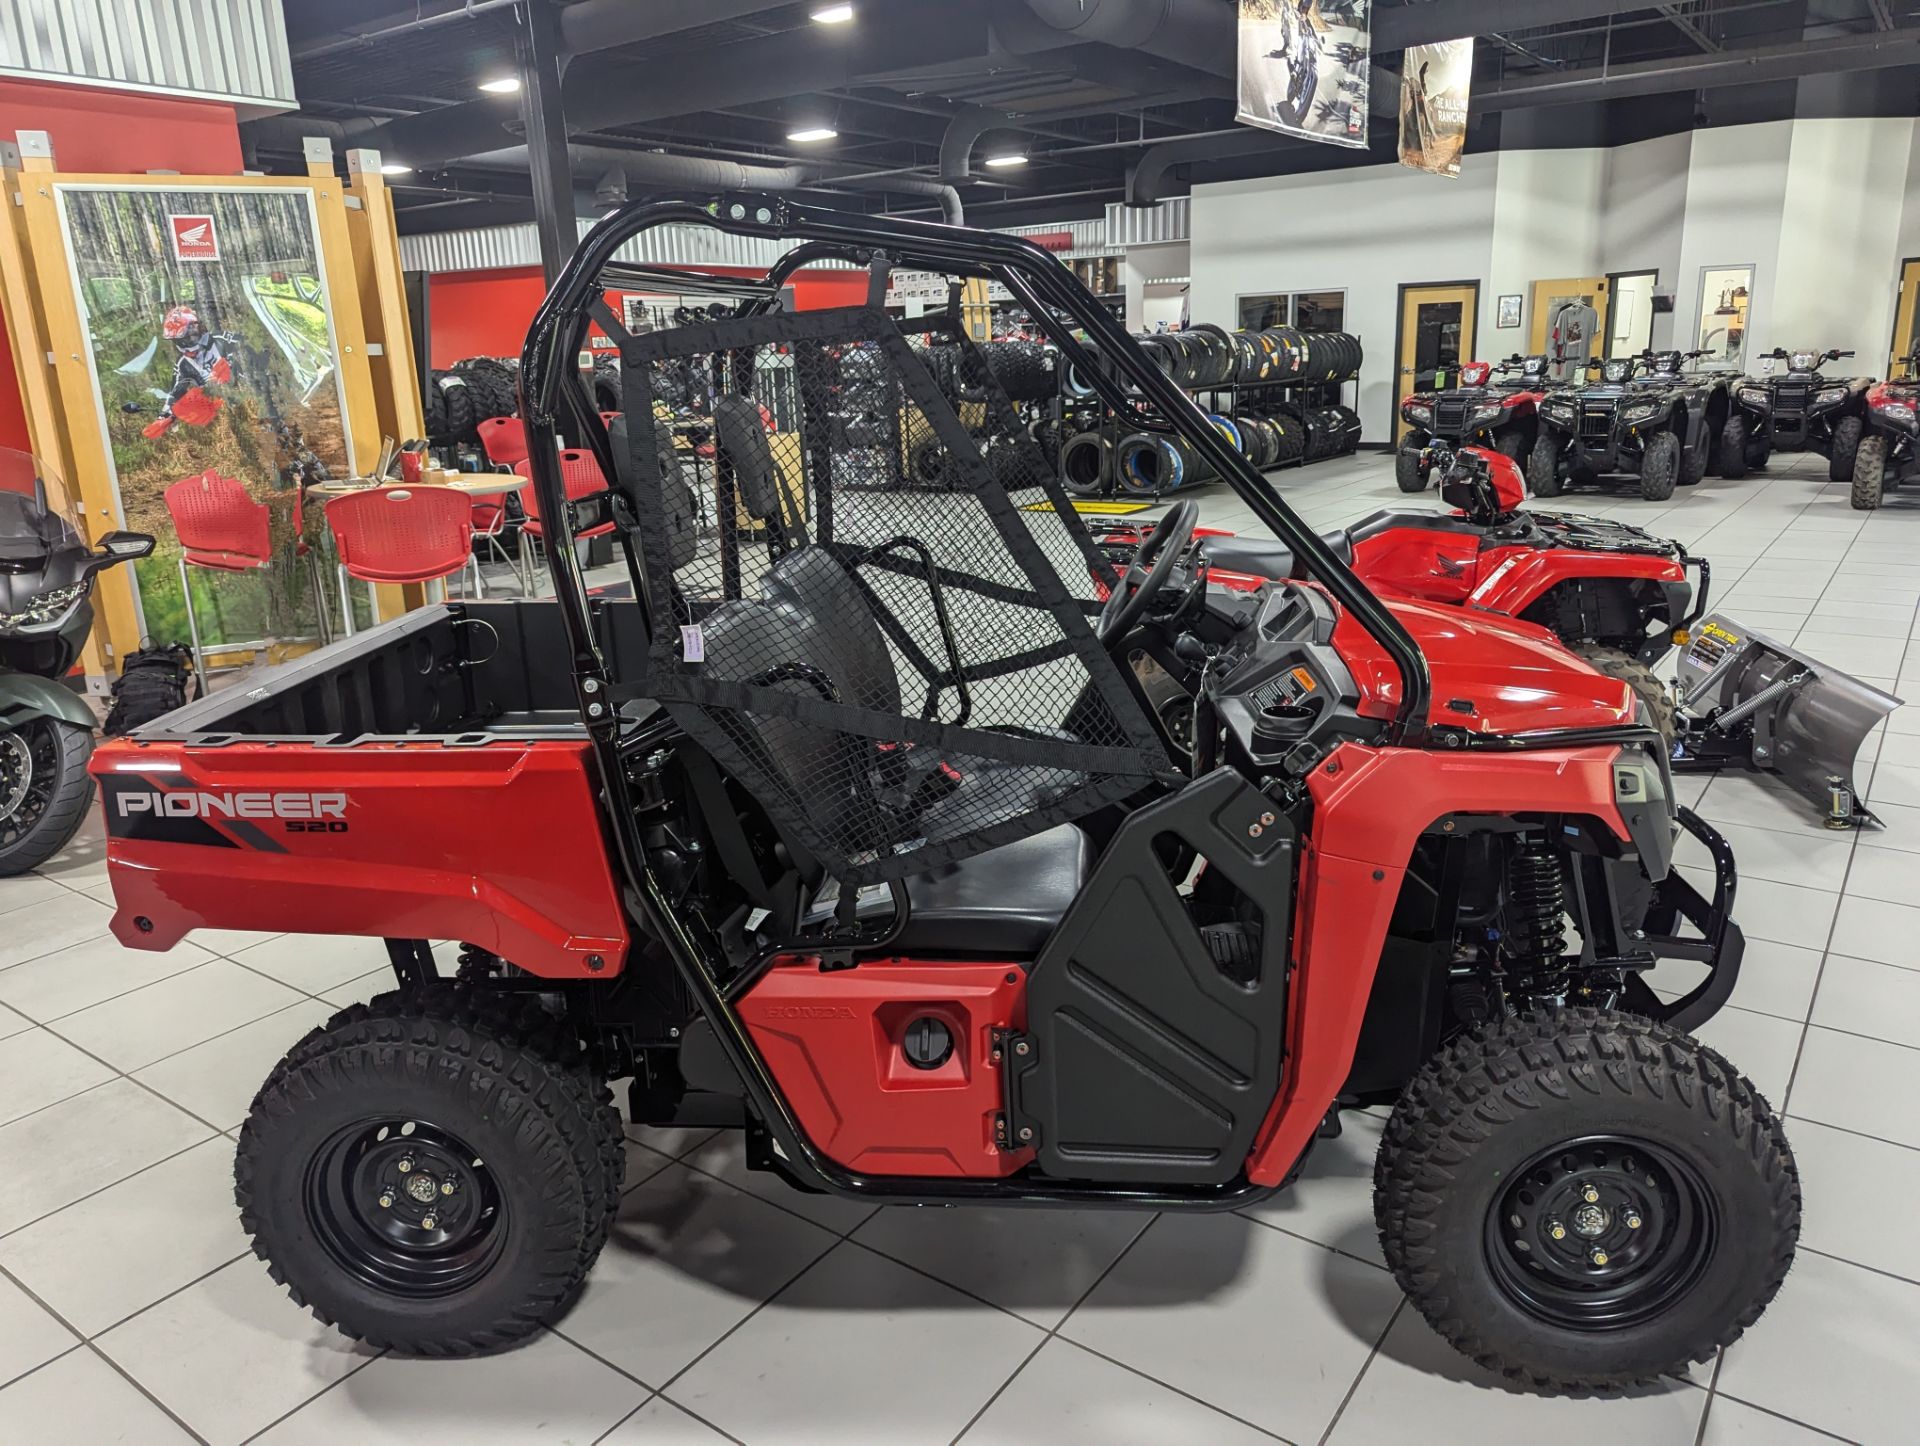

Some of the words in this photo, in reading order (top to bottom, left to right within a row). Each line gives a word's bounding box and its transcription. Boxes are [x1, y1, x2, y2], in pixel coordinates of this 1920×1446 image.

[116, 792, 347, 818] PIONEER
[285, 821, 348, 833] 520
[762, 1006, 857, 1019] HONDA
